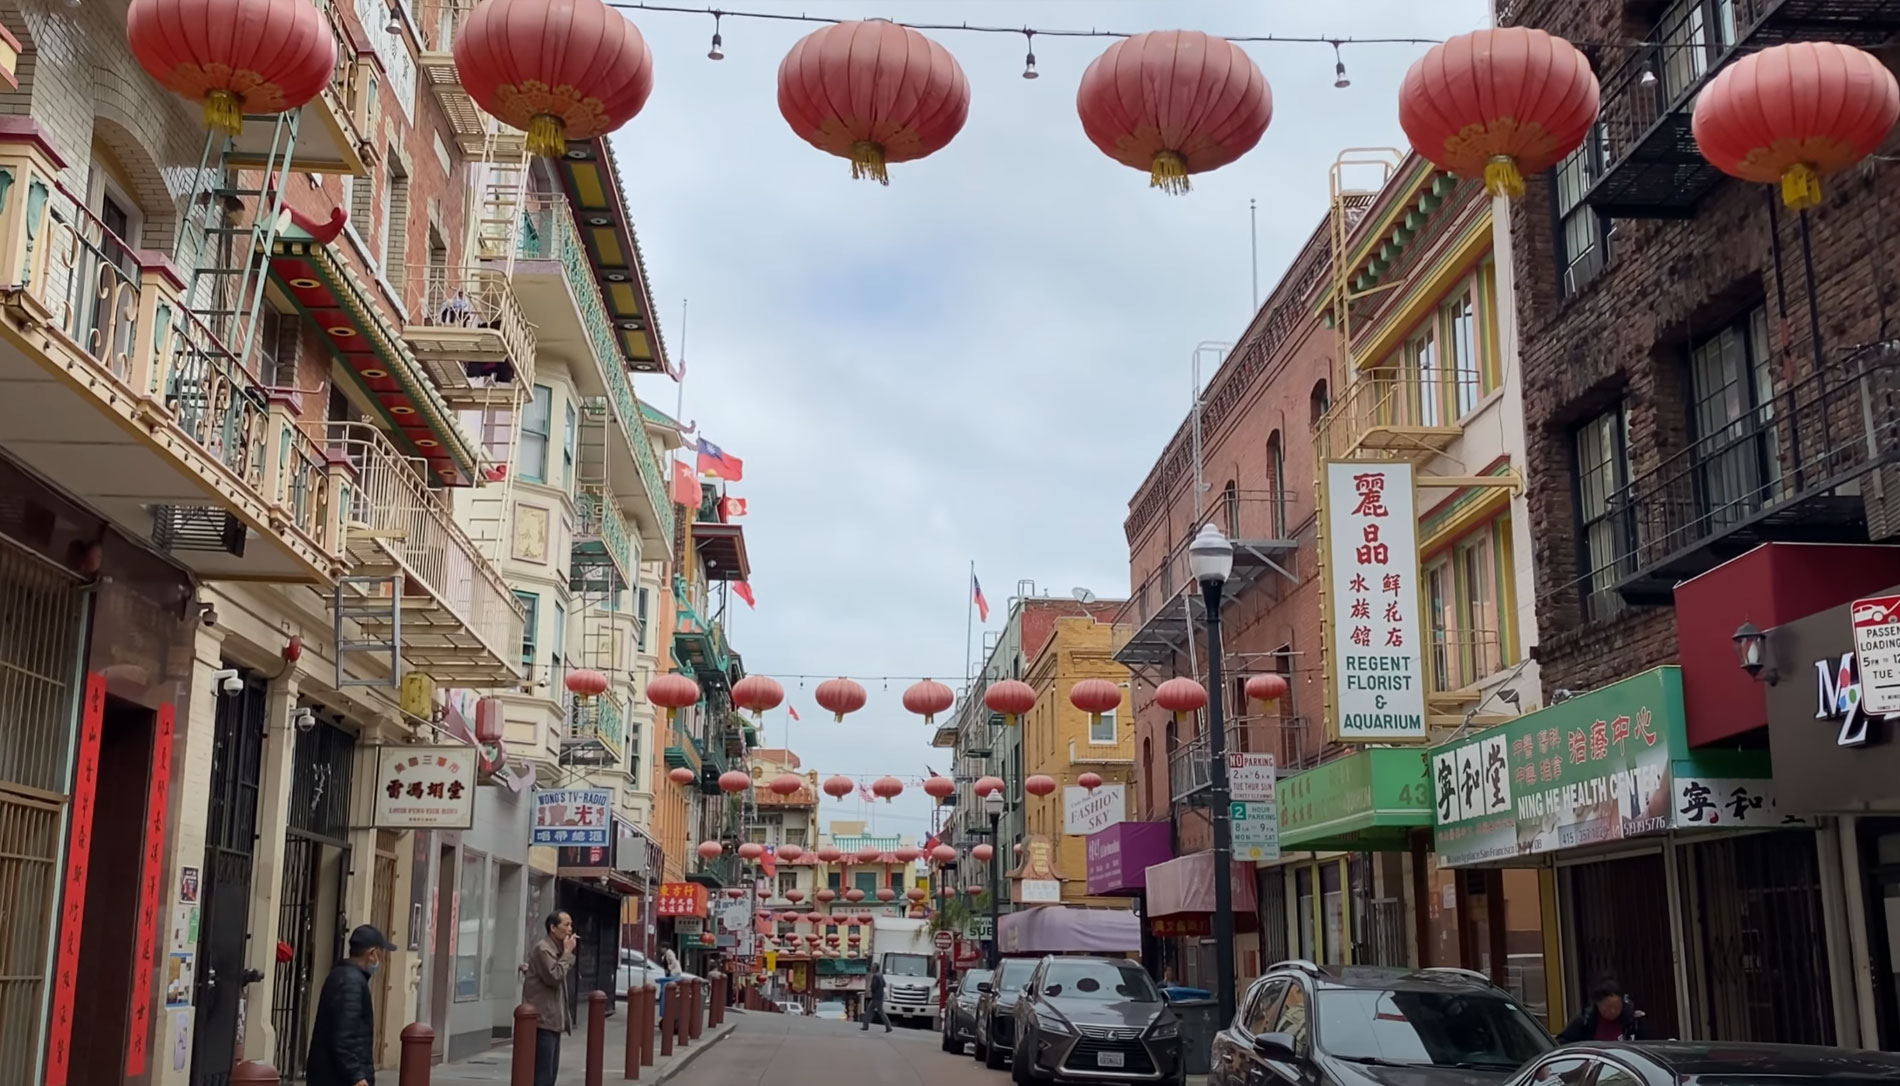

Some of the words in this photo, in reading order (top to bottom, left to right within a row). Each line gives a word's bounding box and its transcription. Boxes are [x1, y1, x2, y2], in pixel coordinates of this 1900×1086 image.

[1351, 472, 1389, 565] 麗晶
[1382, 573, 1404, 647] 鮮花店
[1346, 656, 1411, 671] REGENT
[1873, 669, 1893, 680] TUE
[1346, 675, 1412, 690] FLORIST
[1375, 695, 1388, 709] &
[1343, 713, 1421, 730] AQUARIUM
[1568, 706, 1656, 765] 治療中心
[1229, 754, 1243, 767] NO
[1244, 757, 1274, 768] PARKING
[538, 792, 566, 806] WONG'S
[568, 792, 608, 806] TV-RADIO
[1518, 792, 1546, 821] NING
[1546, 787, 1561, 814] HE
[1562, 775, 1607, 810] HEALTH
[1071, 789, 1119, 824] FASHION
[1234, 806, 1243, 819] 2
[1088, 810, 1109, 831] SKY
[1248, 813, 1276, 821] PARKING
